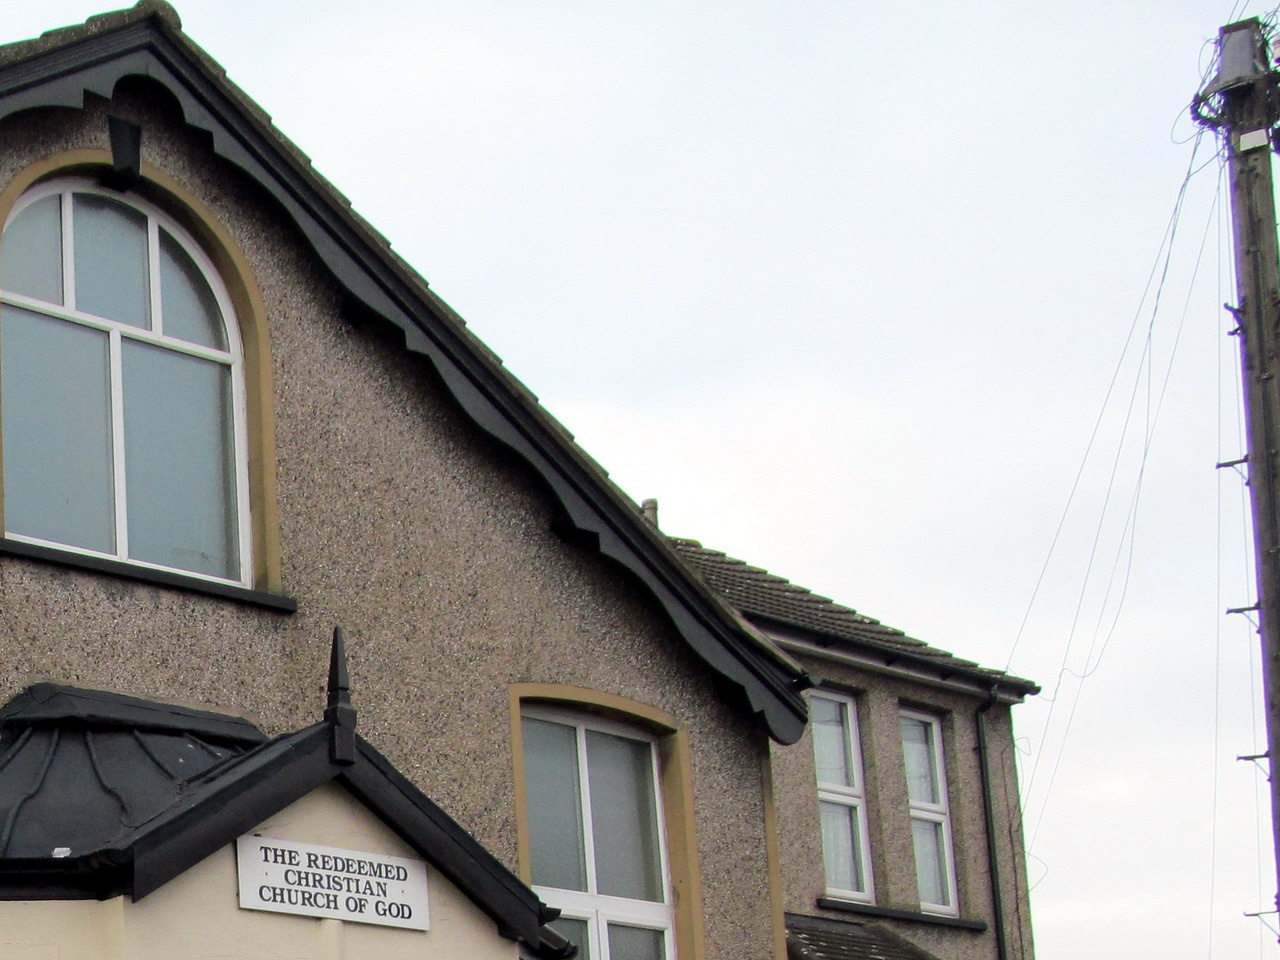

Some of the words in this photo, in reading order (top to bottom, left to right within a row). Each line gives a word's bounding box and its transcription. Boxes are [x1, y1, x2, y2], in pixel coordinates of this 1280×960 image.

[259, 846, 300, 866] THE
[306, 852, 408, 881] REDEEMED
[284, 869, 387, 898] CHRISTIAN
[258, 885, 339, 910] CHURCH
[345, 896, 369, 914] OF
[375, 900, 413, 920] GOD
